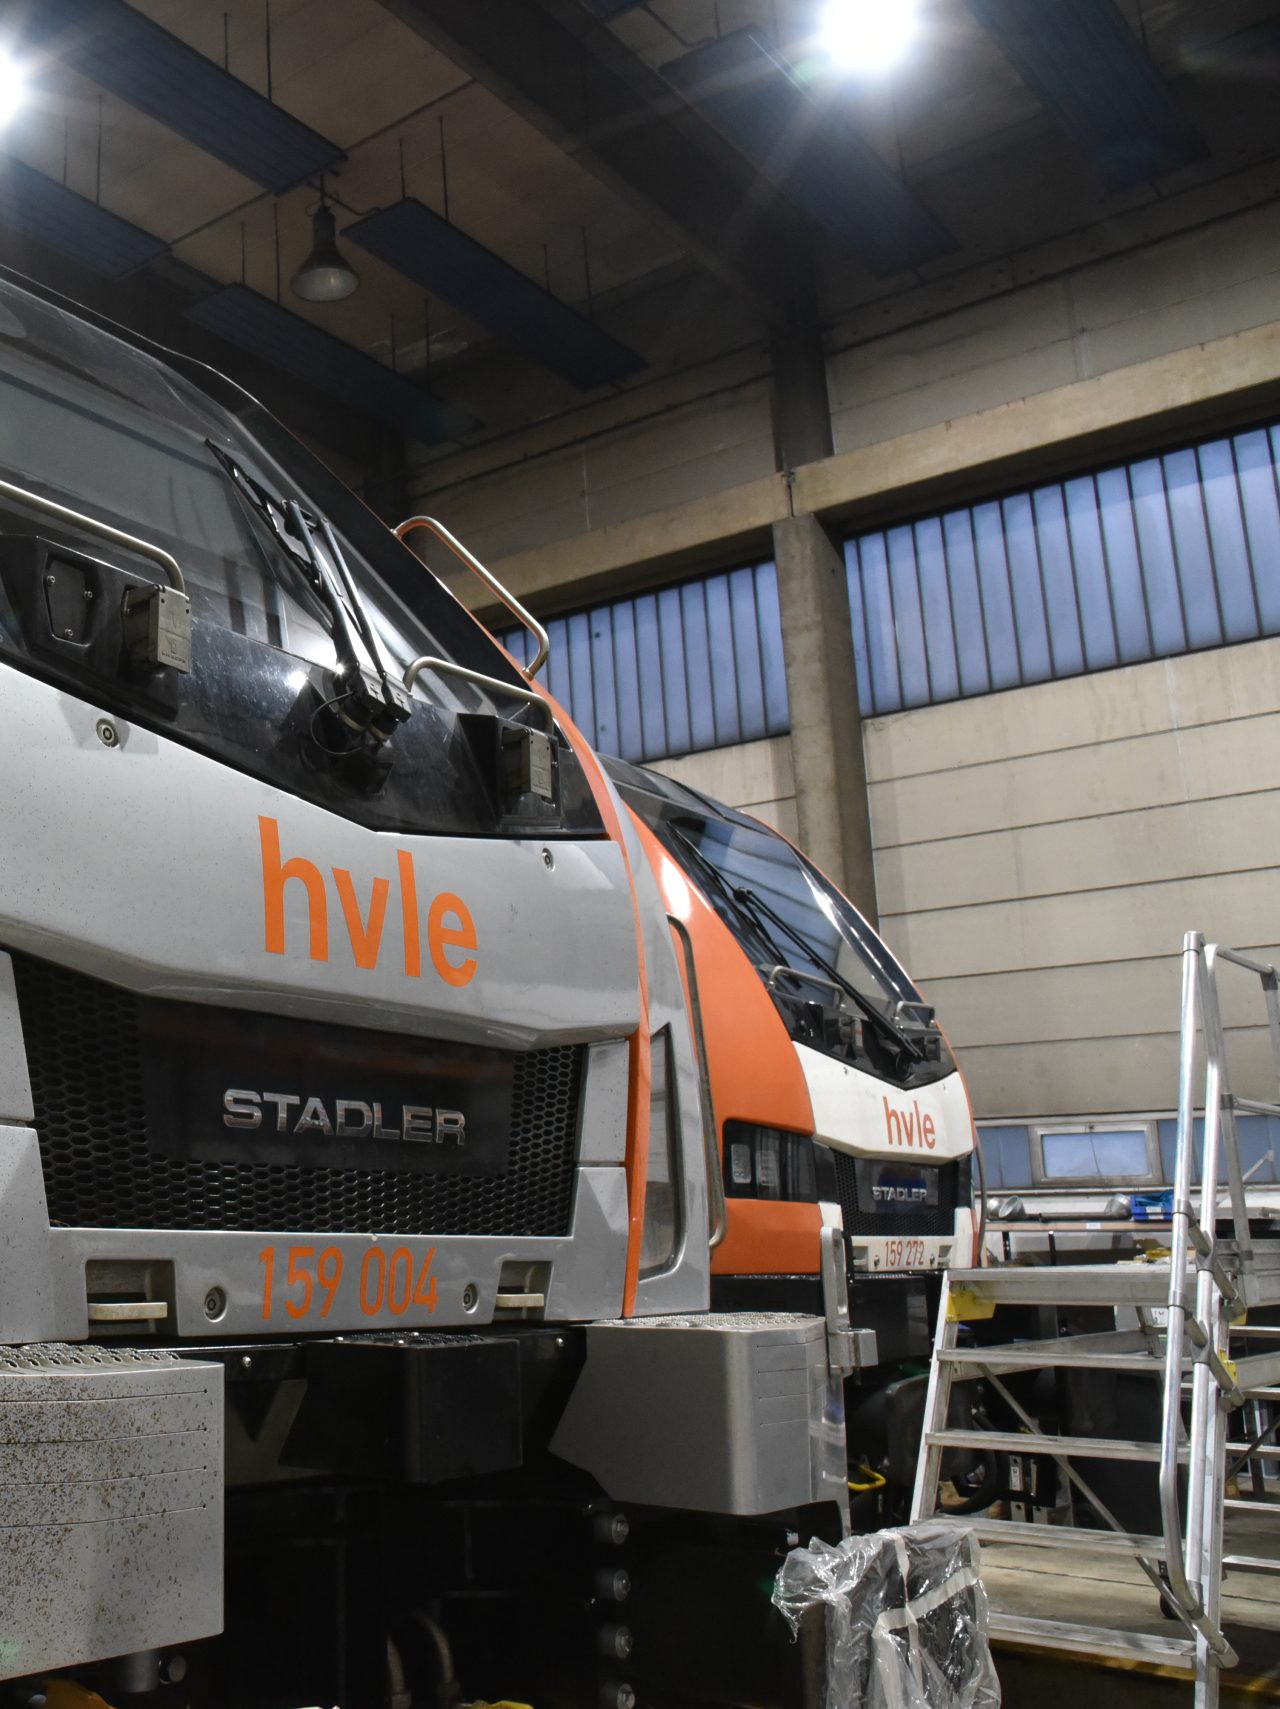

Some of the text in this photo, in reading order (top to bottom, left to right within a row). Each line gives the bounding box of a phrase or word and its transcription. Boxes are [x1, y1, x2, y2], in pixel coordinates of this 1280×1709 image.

[258, 815, 478, 988] hvle
[223, 1088, 466, 1146] STADLER
[883, 1096, 936, 1149] hvle
[872, 1186, 927, 1201] STADLER
[885, 1240, 925, 1267] 159 272
[258, 1246, 439, 1320] 159 004
